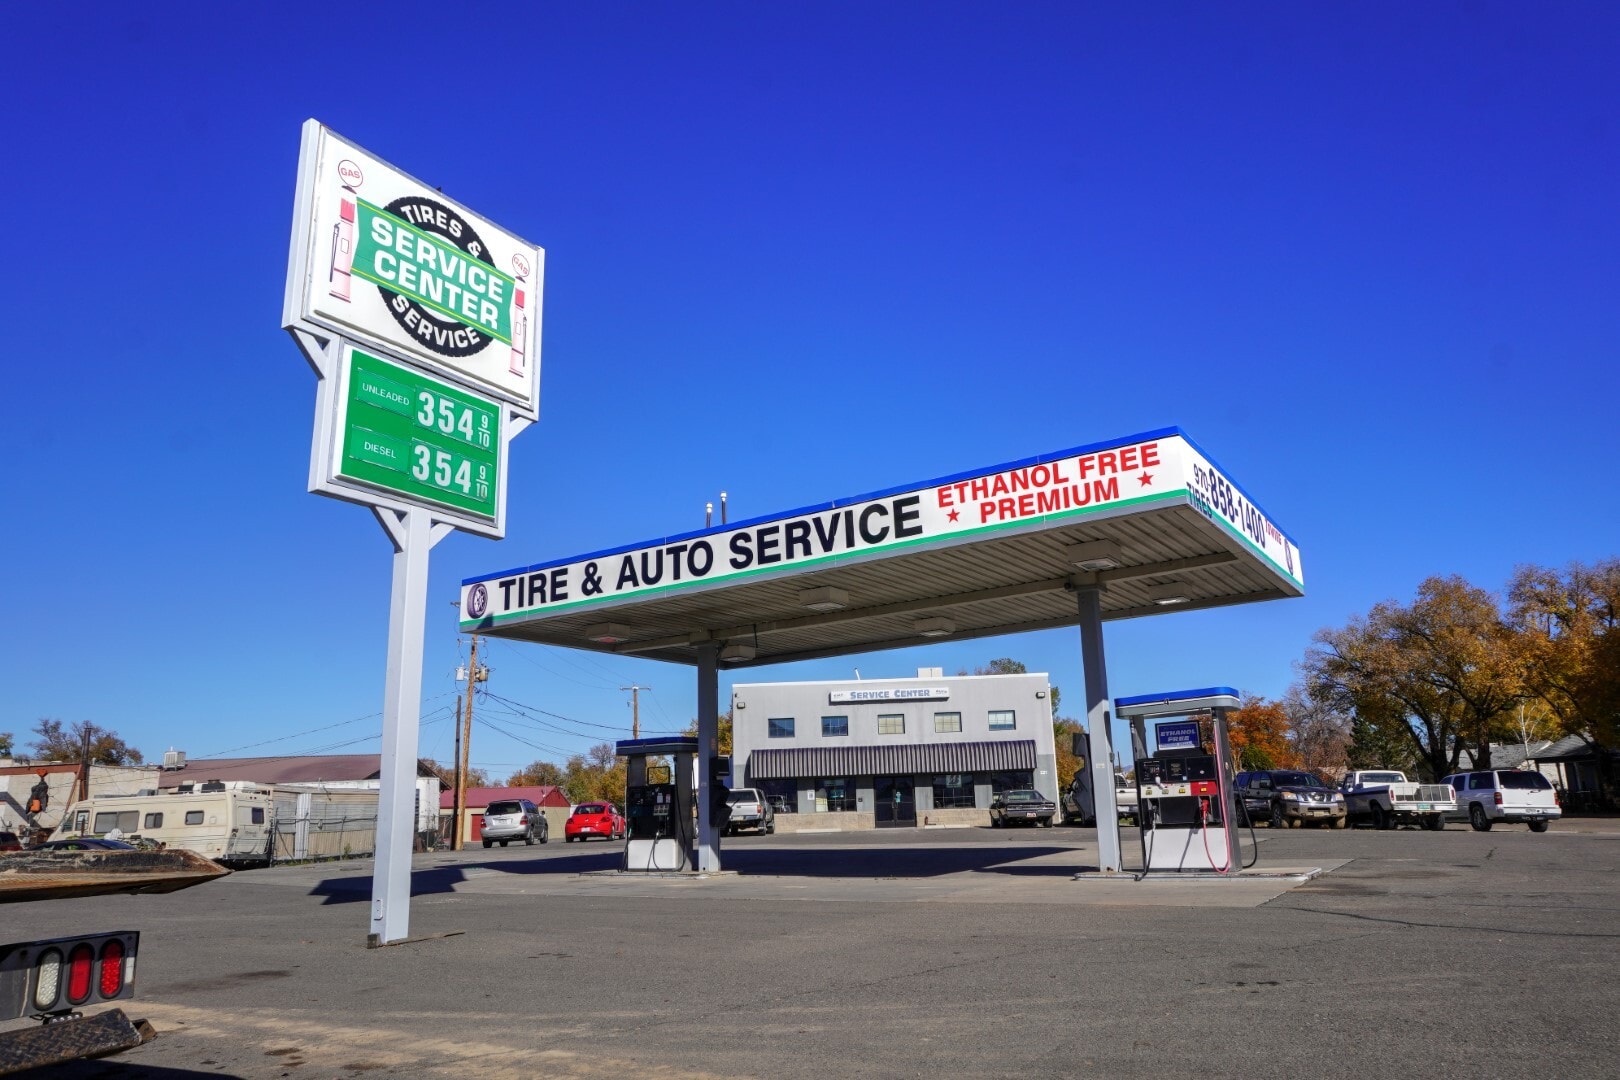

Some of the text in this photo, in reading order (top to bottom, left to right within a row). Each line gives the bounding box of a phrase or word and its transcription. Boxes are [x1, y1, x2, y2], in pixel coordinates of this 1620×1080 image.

[340, 167, 361, 179] GAS
[401, 204, 482, 258] TIRES &
[371, 216, 503, 303] SERVICE
[512, 256, 530, 276] GAS
[374, 250, 498, 331] CENTER
[391, 294, 481, 349] SERVICE
[362, 382, 410, 406] UNLEADED
[417, 391, 474, 441] 354
[364, 440, 397, 459] DIESEL
[412, 444, 471, 494] 354
[937, 443, 1161, 508] ETHANOL FREE
[980, 477, 1119, 524] PREMIUM
[1186, 481, 1213, 519] TIRES
[499, 495, 923, 611] TIRE & AUTO SERVICE
[1160, 729, 1196, 737] ETHANOL
